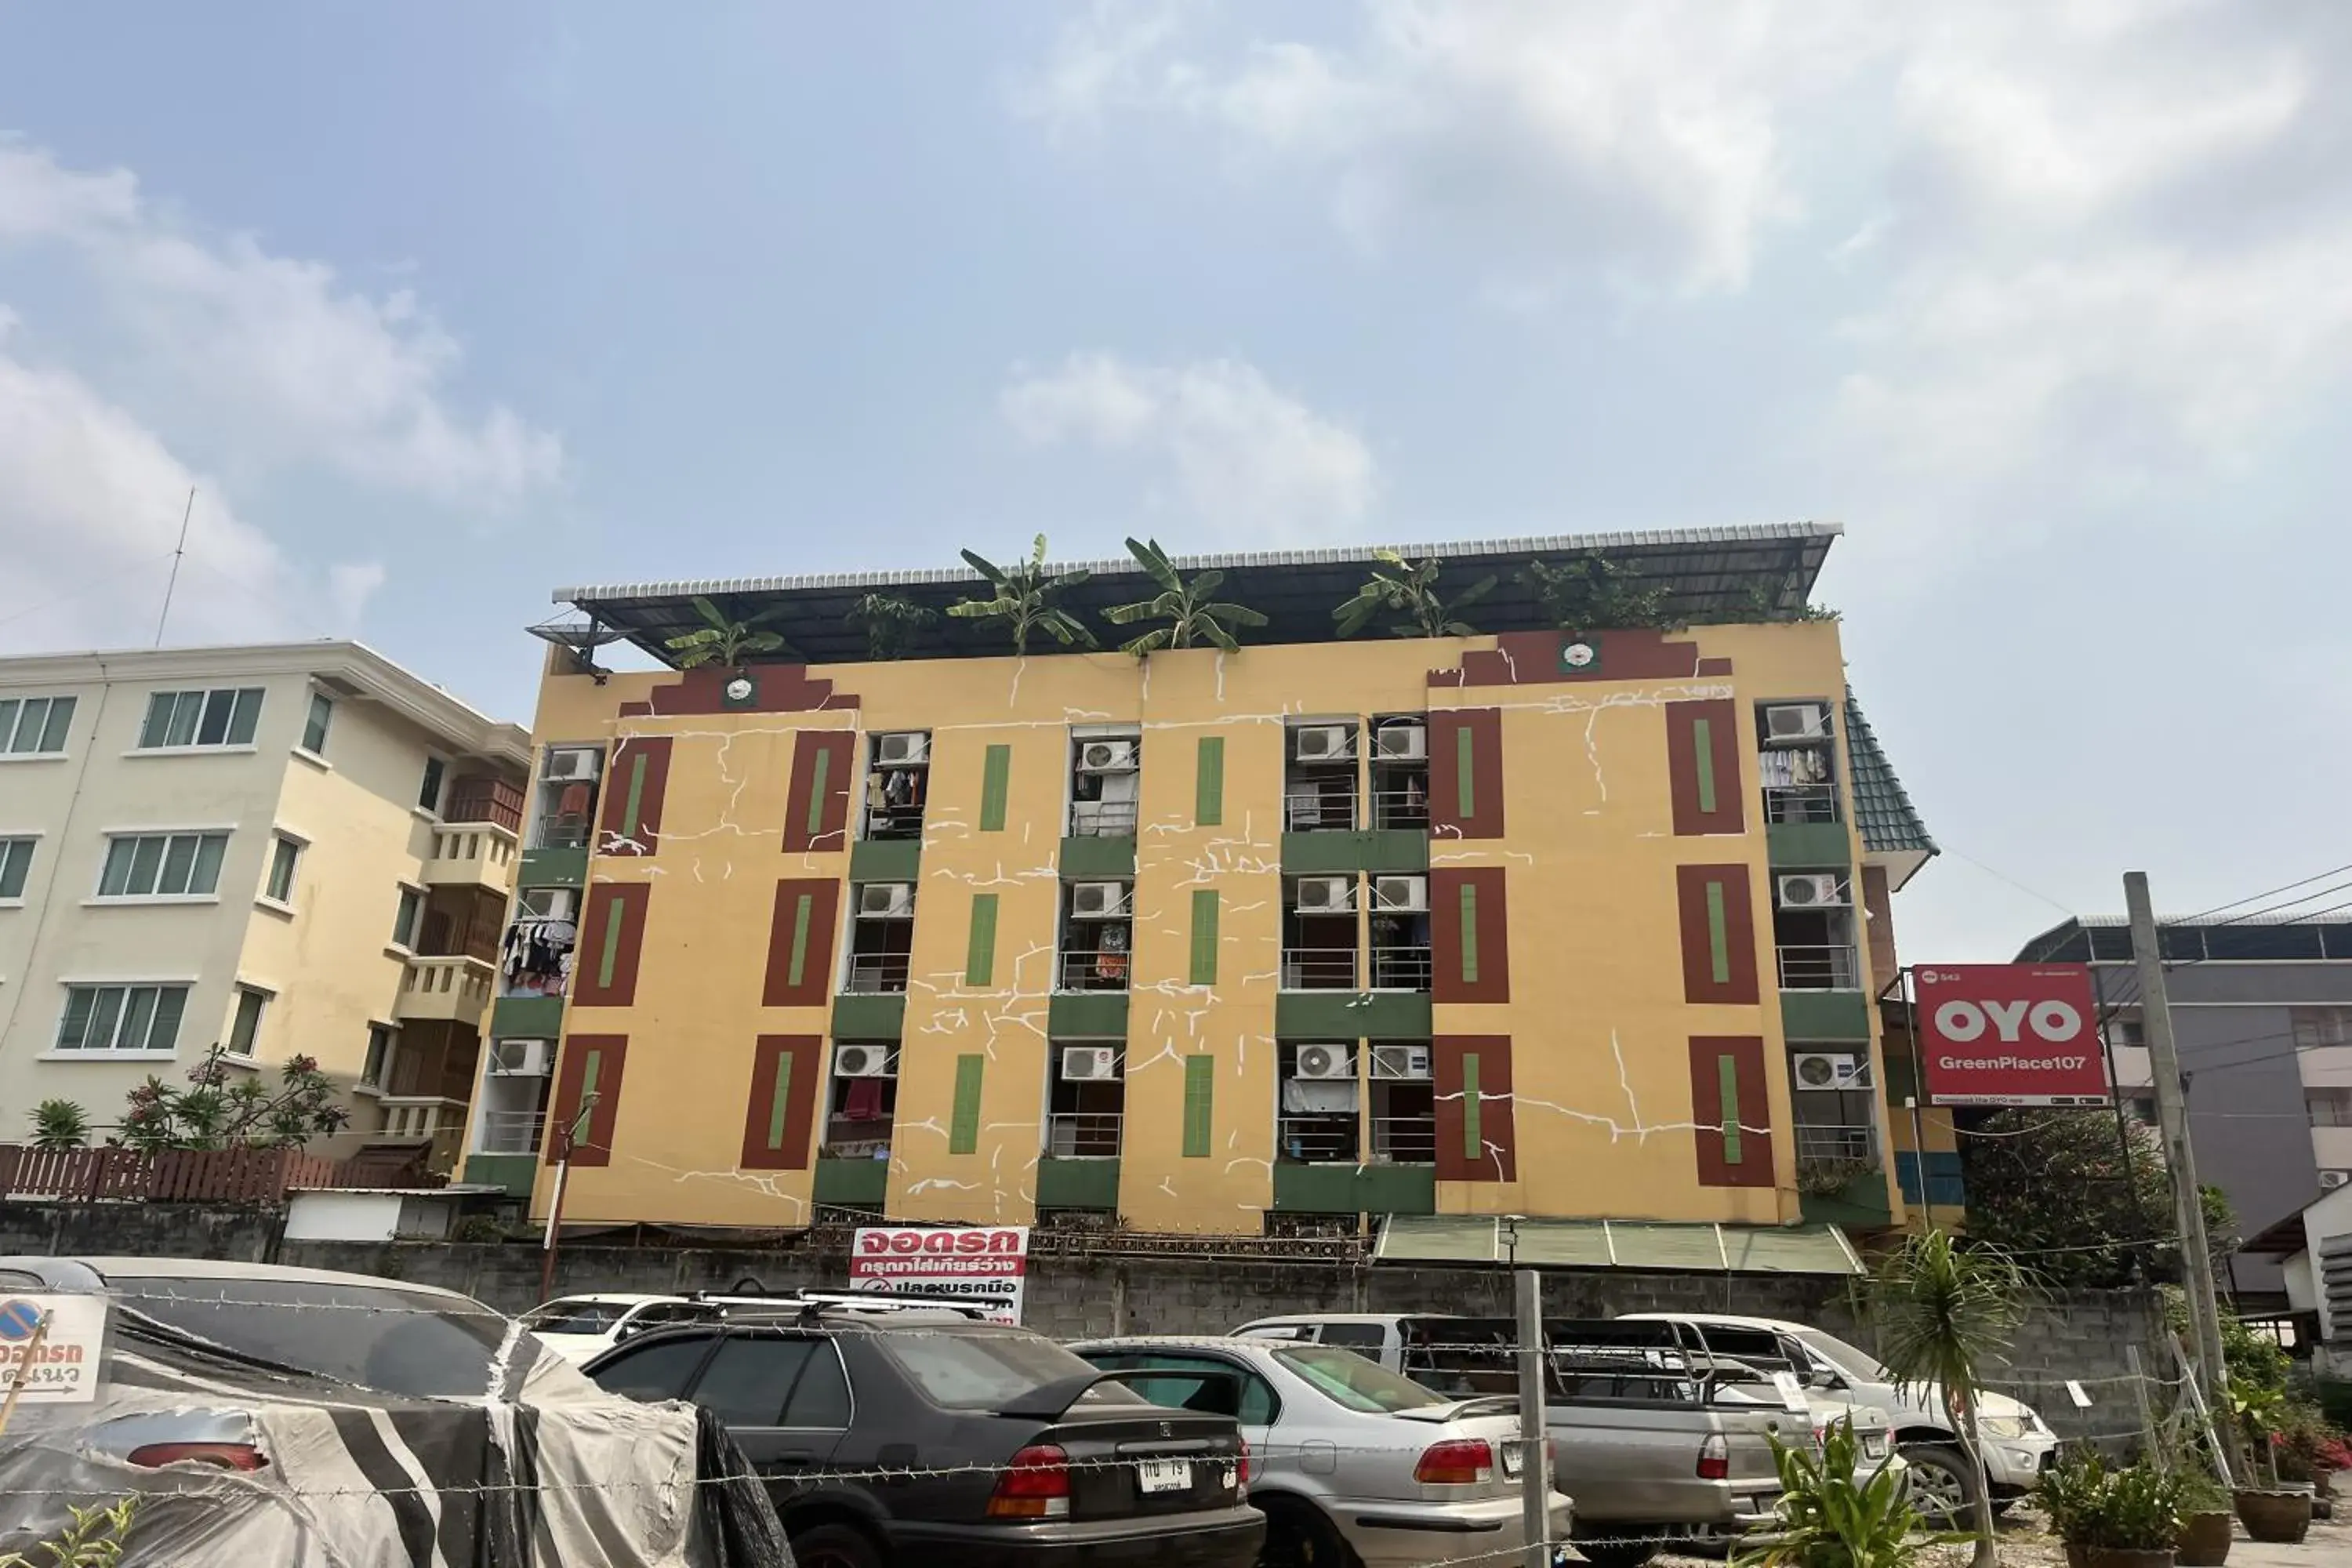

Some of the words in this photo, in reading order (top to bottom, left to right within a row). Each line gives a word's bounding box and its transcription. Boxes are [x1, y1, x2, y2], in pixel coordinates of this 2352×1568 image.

[1934, 1000, 2082, 1042] OYO
[1939, 1056, 2086, 1069] GreenPlace107
[861, 1231, 1020, 1254] จอดรถ
